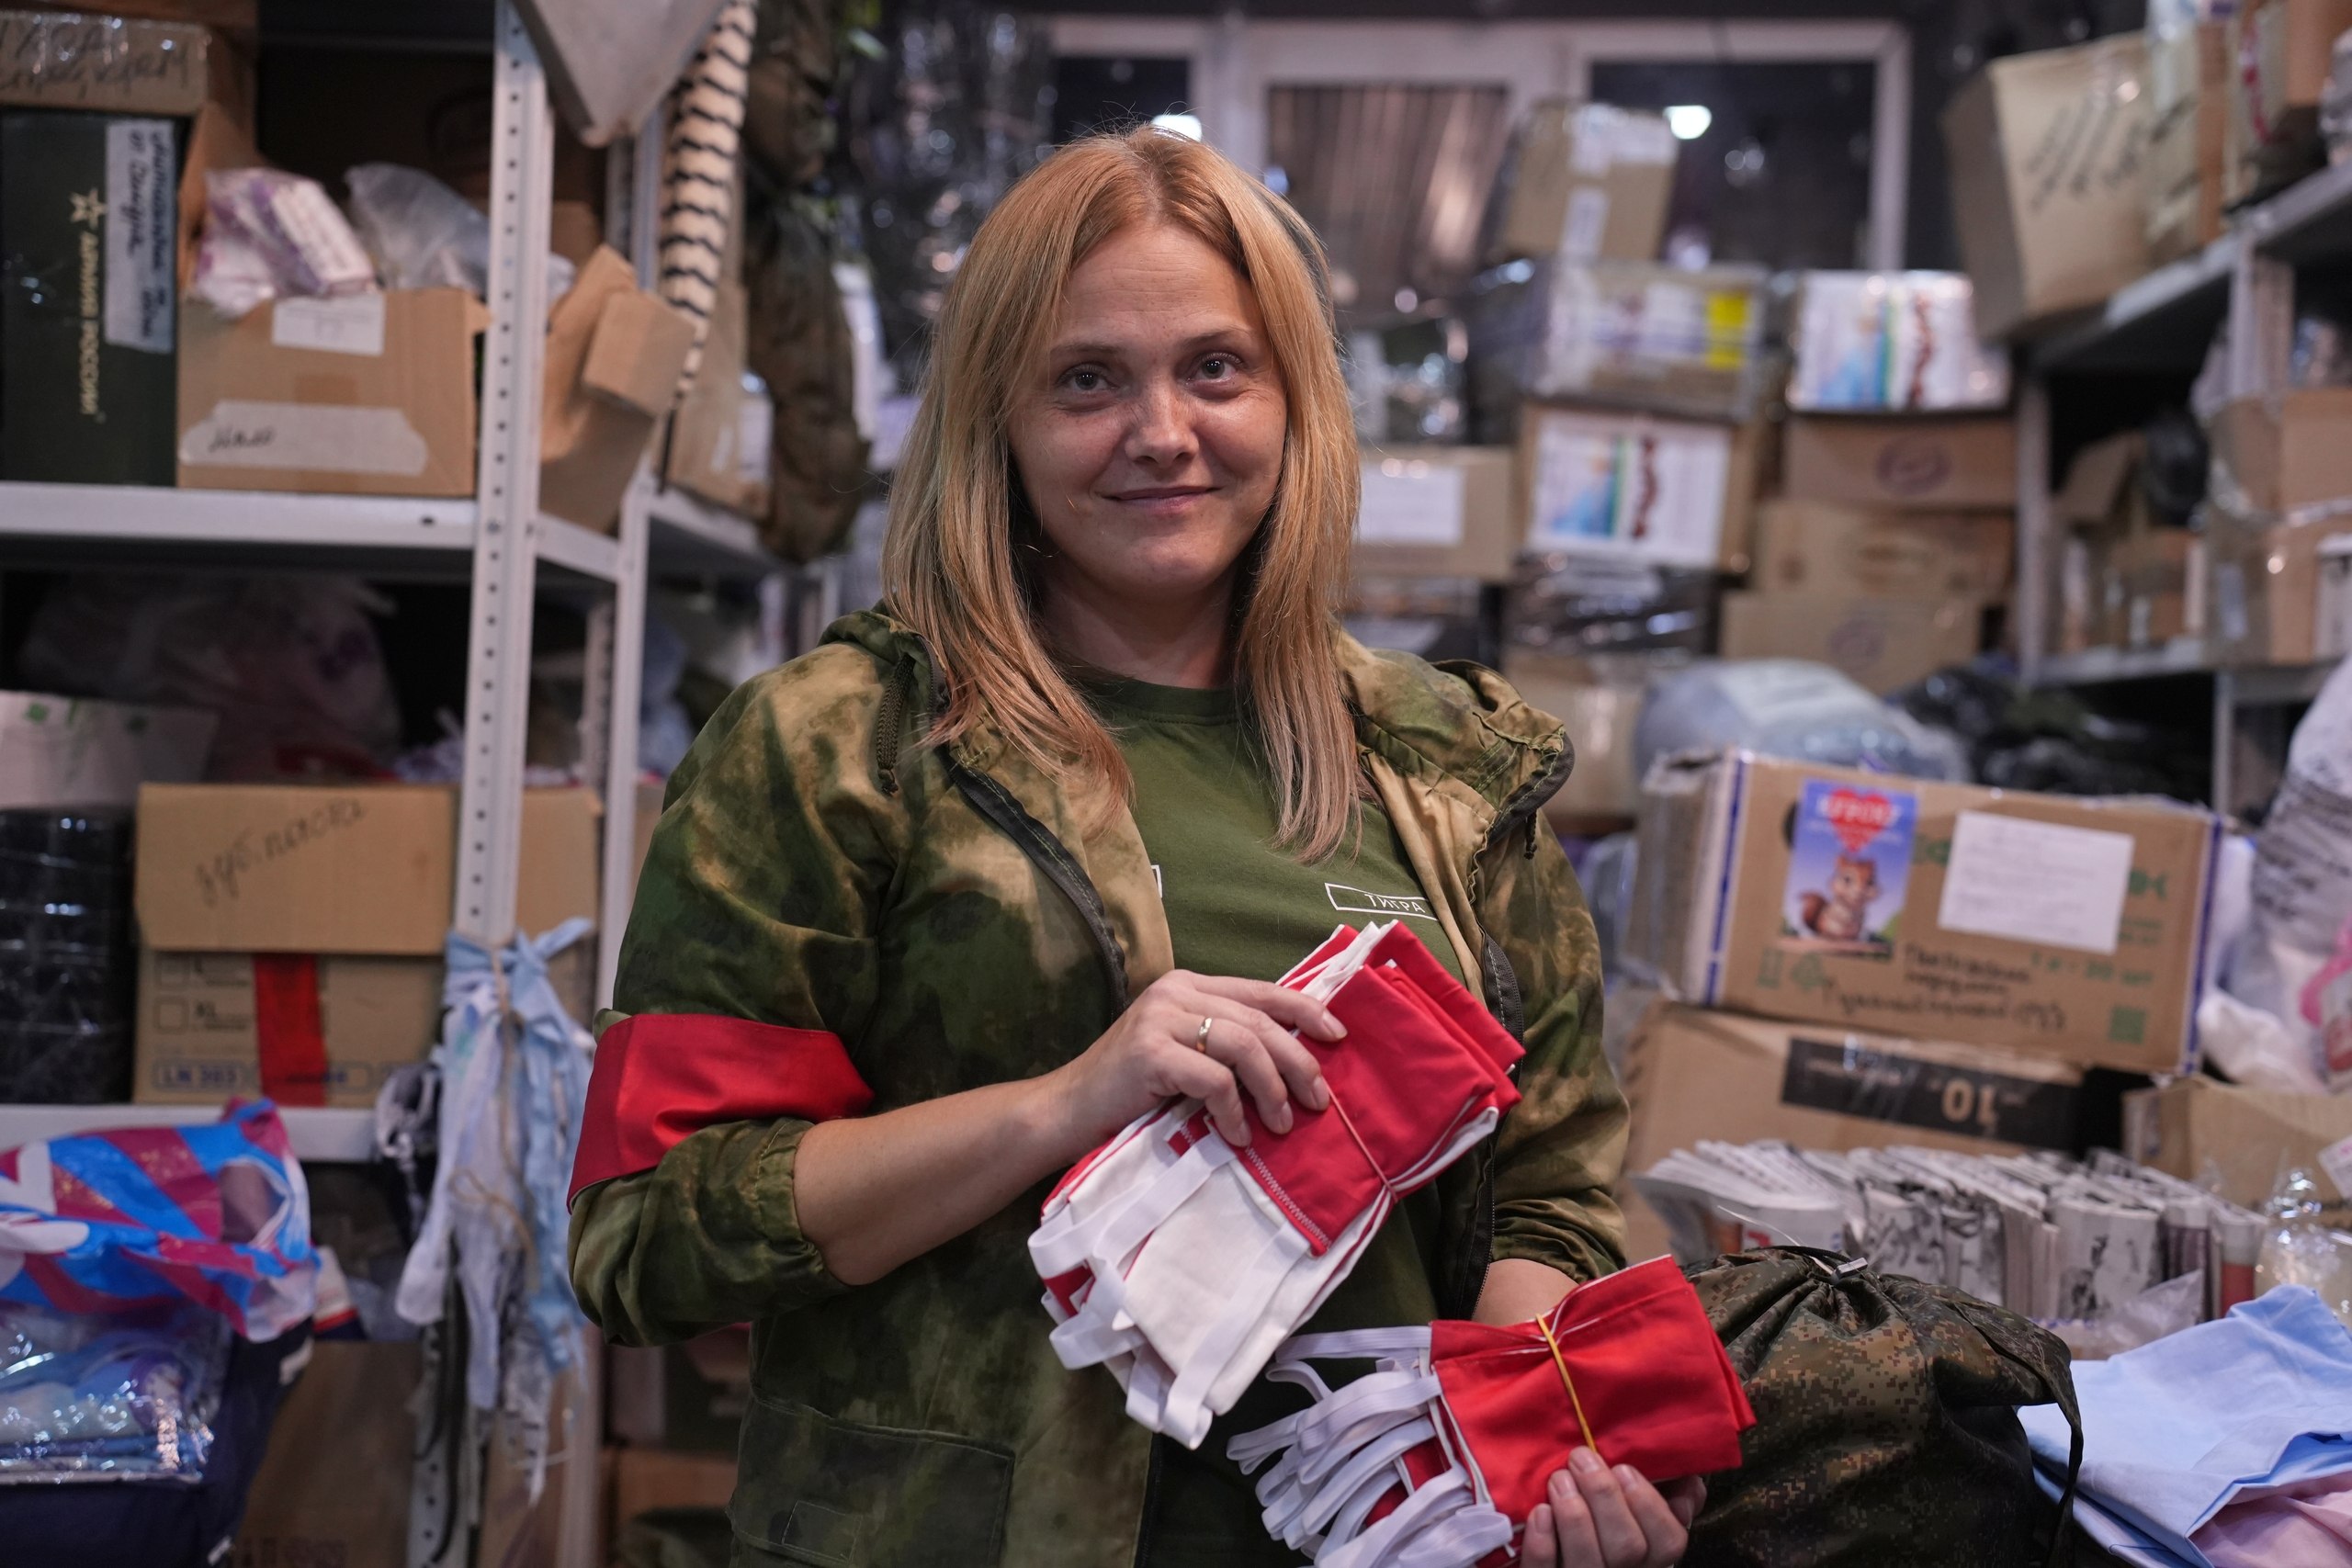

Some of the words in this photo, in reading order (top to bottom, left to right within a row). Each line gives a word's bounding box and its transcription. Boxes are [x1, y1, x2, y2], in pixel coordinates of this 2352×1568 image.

[79, 231, 99, 316] АРМИЯ
[79, 320, 99, 414] РОССИИ
[1364, 894, 1426, 913] ТИГРА
[1940, 1077, 1997, 1127] 10
